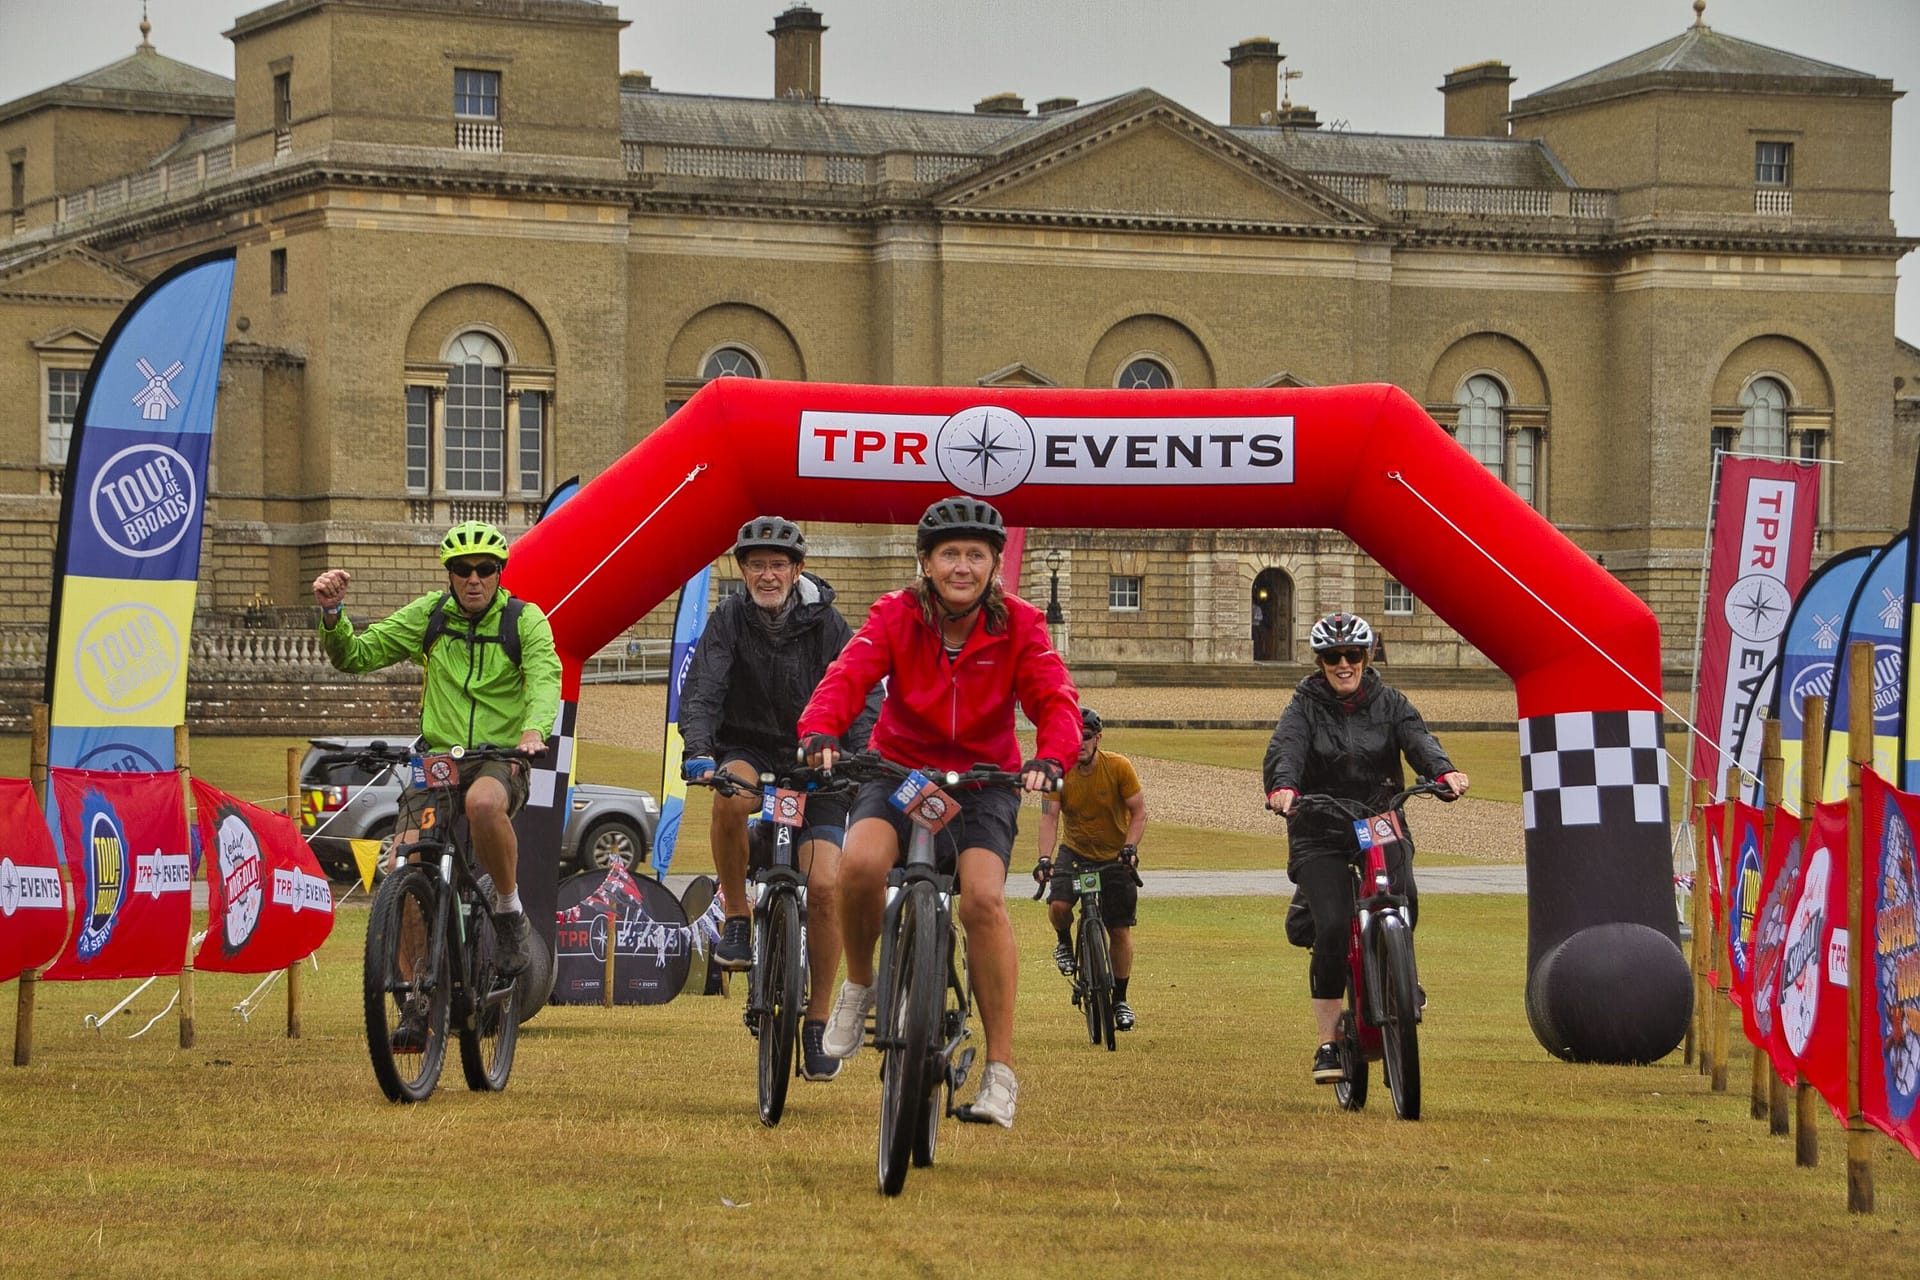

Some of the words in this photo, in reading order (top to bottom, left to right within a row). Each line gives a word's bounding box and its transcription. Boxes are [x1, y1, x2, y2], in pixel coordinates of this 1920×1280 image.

[813, 428, 929, 465] TPR
[1045, 433, 1284, 468] EVENTS
[101, 455, 173, 521] TOUR
[124, 492, 188, 545] BROADS
[1751, 490, 1783, 569] TPR
[86, 614, 158, 677] TOUR
[20, 877, 60, 898] EVENTS
[163, 865, 189, 883] EVENTS
[276, 878, 292, 897] TPR
[305, 883, 331, 904] EVENTS
[559, 930, 588, 947] TPR
